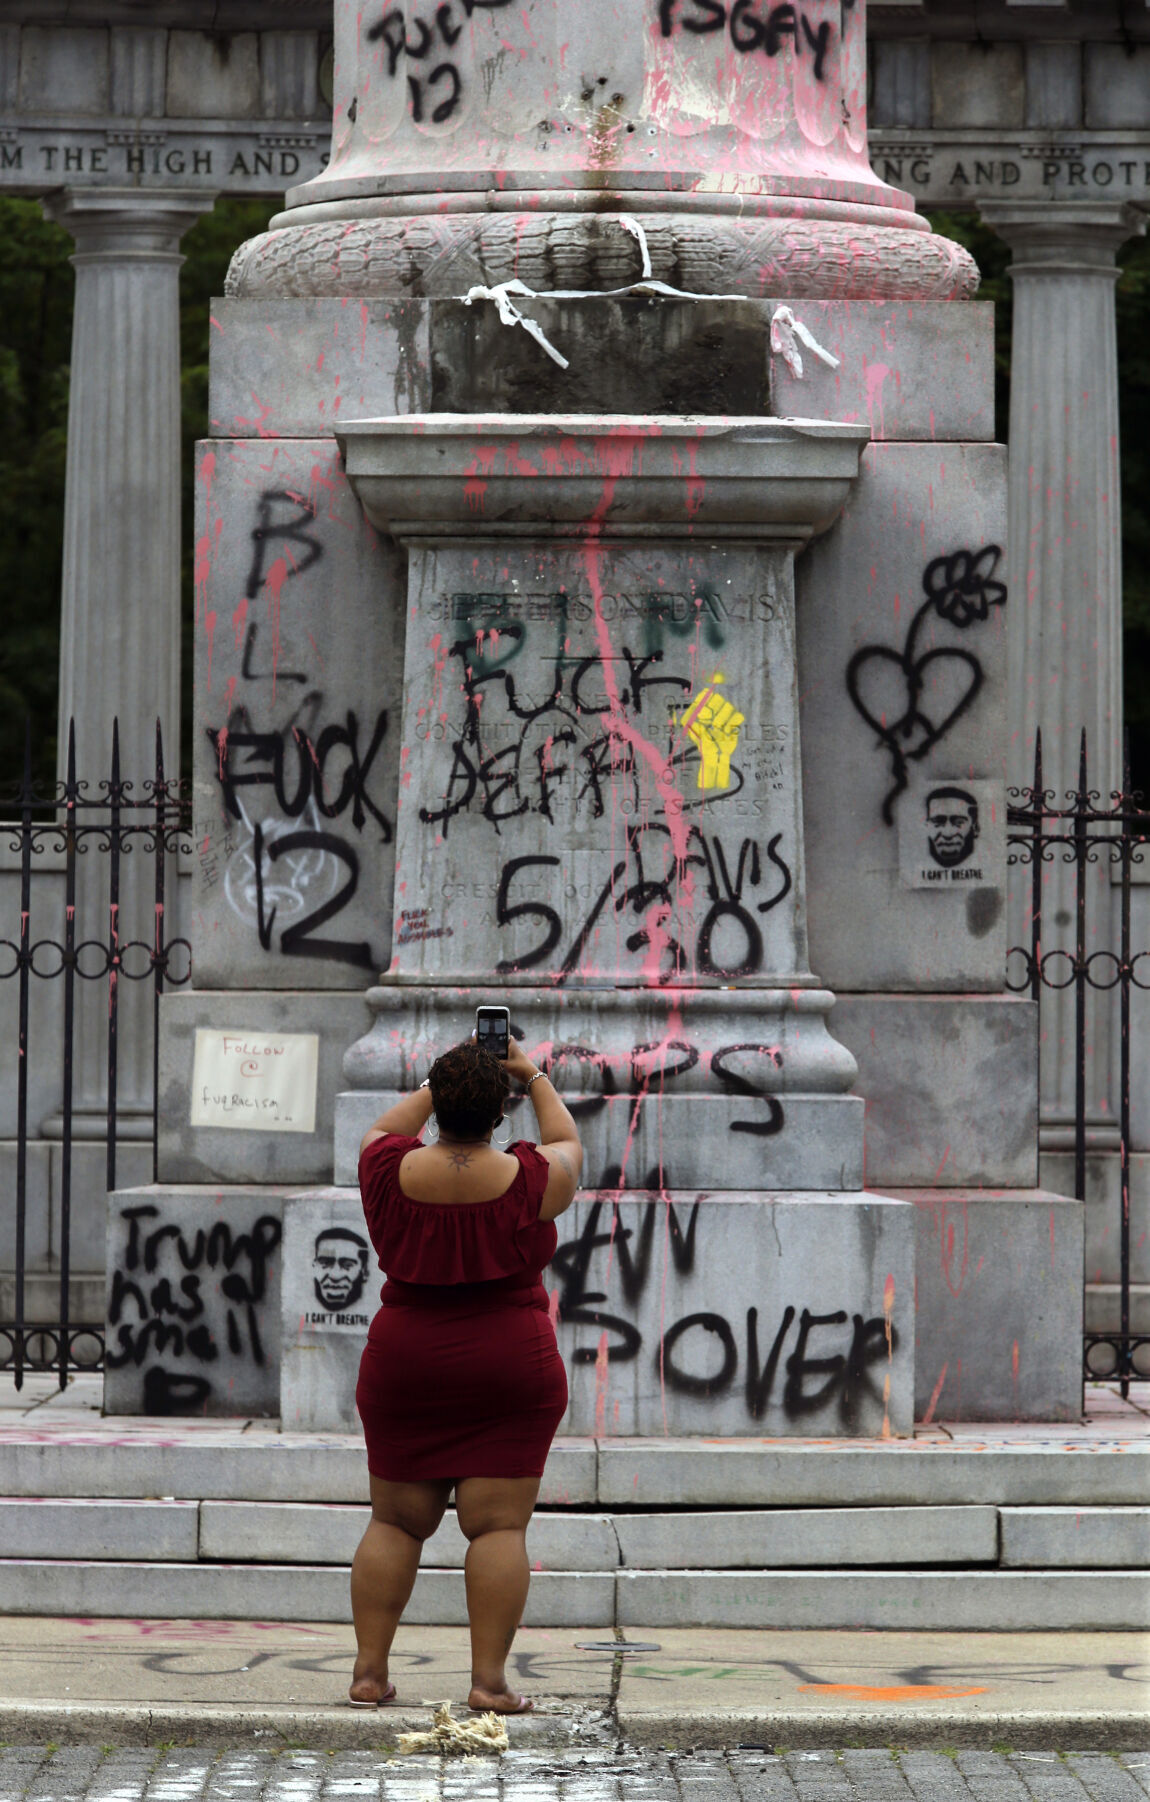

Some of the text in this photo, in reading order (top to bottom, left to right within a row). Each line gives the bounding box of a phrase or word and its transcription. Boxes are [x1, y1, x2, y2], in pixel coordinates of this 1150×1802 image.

[406, 62, 462, 124] 12
[40, 147, 109, 172] THE
[126, 149, 212, 175] HIGH
[229, 151, 299, 176] AND
[949, 163, 1022, 186] AND
[669, 592, 775, 624] DAVIS
[449, 622, 694, 748] FUCK
[206, 708, 392, 843] FUCK
[252, 822, 384, 972] 12
[627, 821, 793, 913] DAVIS
[120, 1205, 283, 1301] Trump
[655, 1305, 902, 1428] OVER
